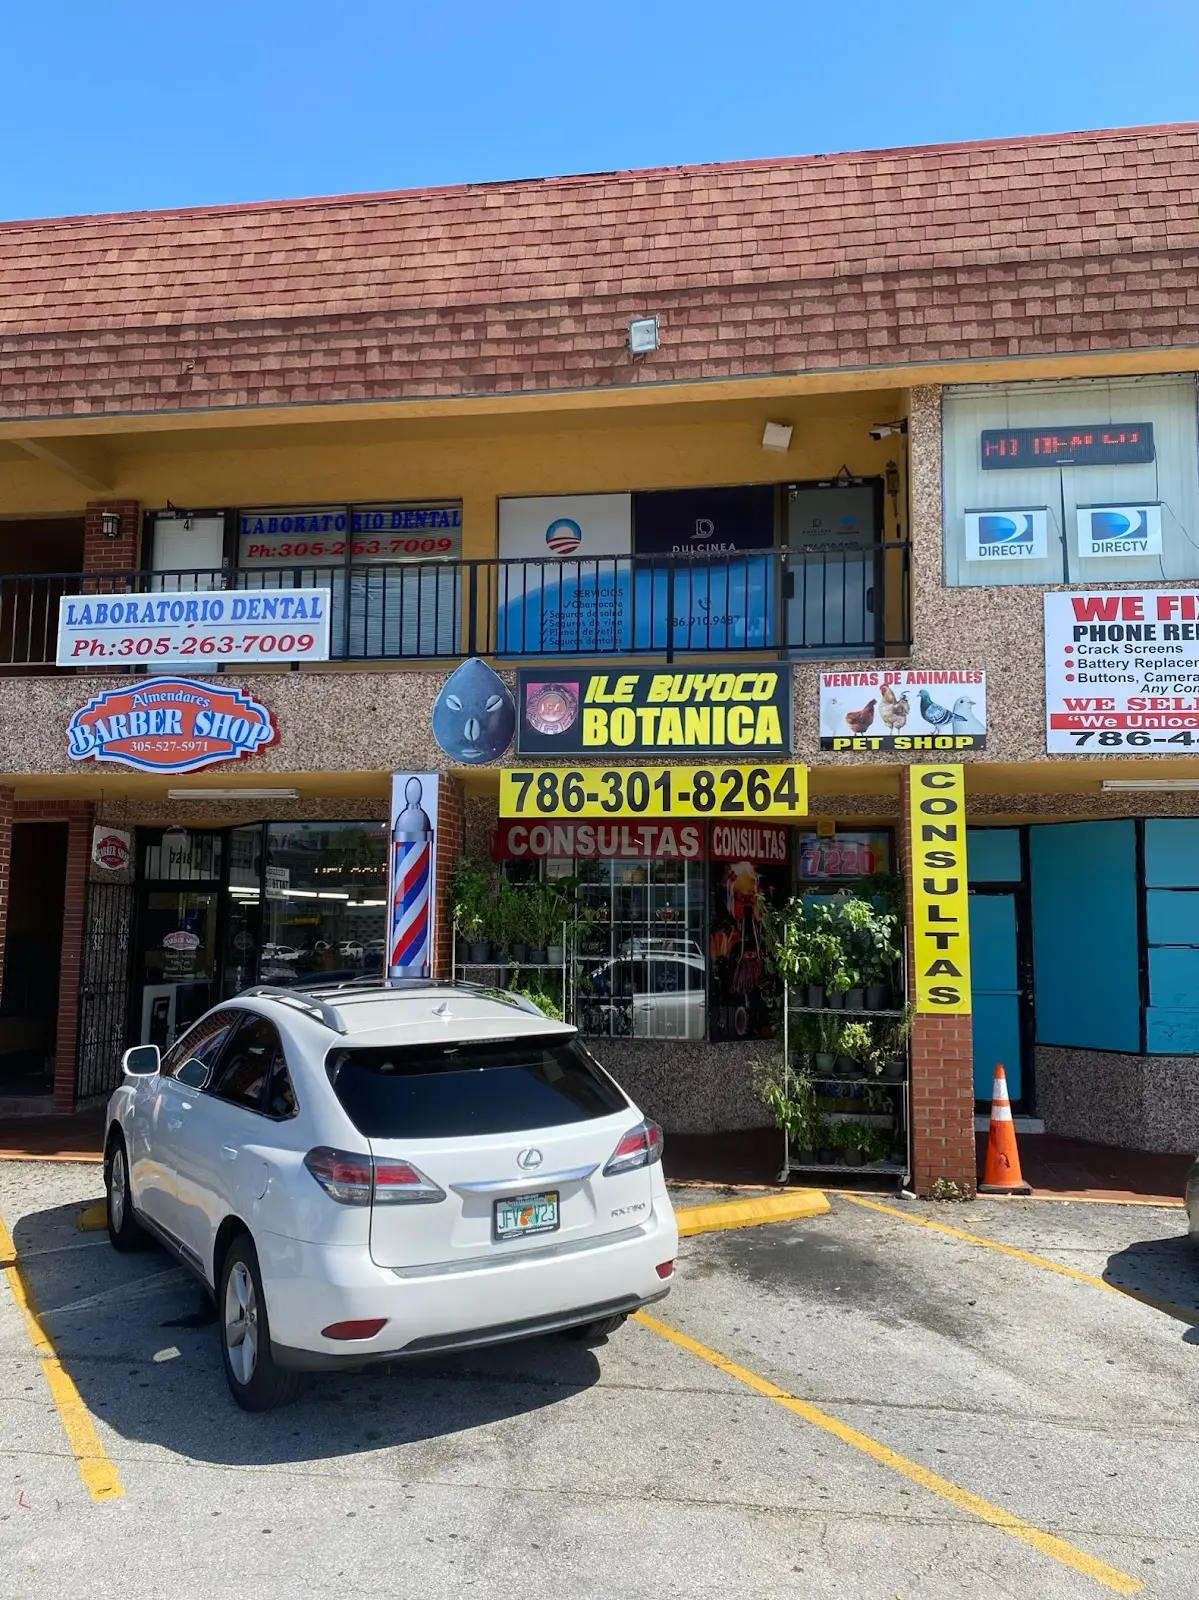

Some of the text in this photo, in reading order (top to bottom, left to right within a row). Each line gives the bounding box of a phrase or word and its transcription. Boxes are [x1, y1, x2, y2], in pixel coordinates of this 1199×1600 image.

[183, 519, 191, 531] 4
[241, 510, 462, 535] LABORATORIO DENTAL
[247, 538, 453, 558] Ph:305-263-7009
[672, 542, 736, 553] DULCINEA
[979, 545, 1034, 557] DIRECTV
[1091, 540, 1148, 553] DIRECTV
[66, 597, 323, 626] LABORATORIO DENTAL
[572, 600, 623, 609] Obamacae
[1071, 596, 1145, 622] WE
[549, 619, 586, 628] Segurs
[598, 627, 623, 635] retio
[586, 636, 623, 645] dentals
[1073, 623, 1199, 642] PHONE RE
[70, 634, 315, 657] Ph:305-263-7009
[1077, 643, 1184, 655] Crack Screens
[1078, 658, 1130, 670] Battery
[823, 671, 983, 687] VENTAS DE ANIMALES
[1078, 672, 1139, 684] Buttons,
[584, 672, 778, 704] ILE BUYOCO
[1140, 684, 1169, 695] Any
[131, 690, 211, 710] Almendares
[1063, 698, 1116, 711] WE
[70, 708, 272, 755] BARBER SHOP
[582, 705, 783, 746] BOTANICA
[130, 741, 209, 752] 305-527-5971
[833, 736, 974, 750] PET SHOP
[1069, 731, 1199, 747] 786-4
[511, 767, 800, 813] 786-301-8264
[507, 825, 700, 857] CONSULTAS
[713, 827, 787, 860] CONSULTAS
[807, 850, 876, 875] 7220
[920, 771, 963, 1005] CONSULTAS
[498, 1203, 555, 1229] JFV V23
